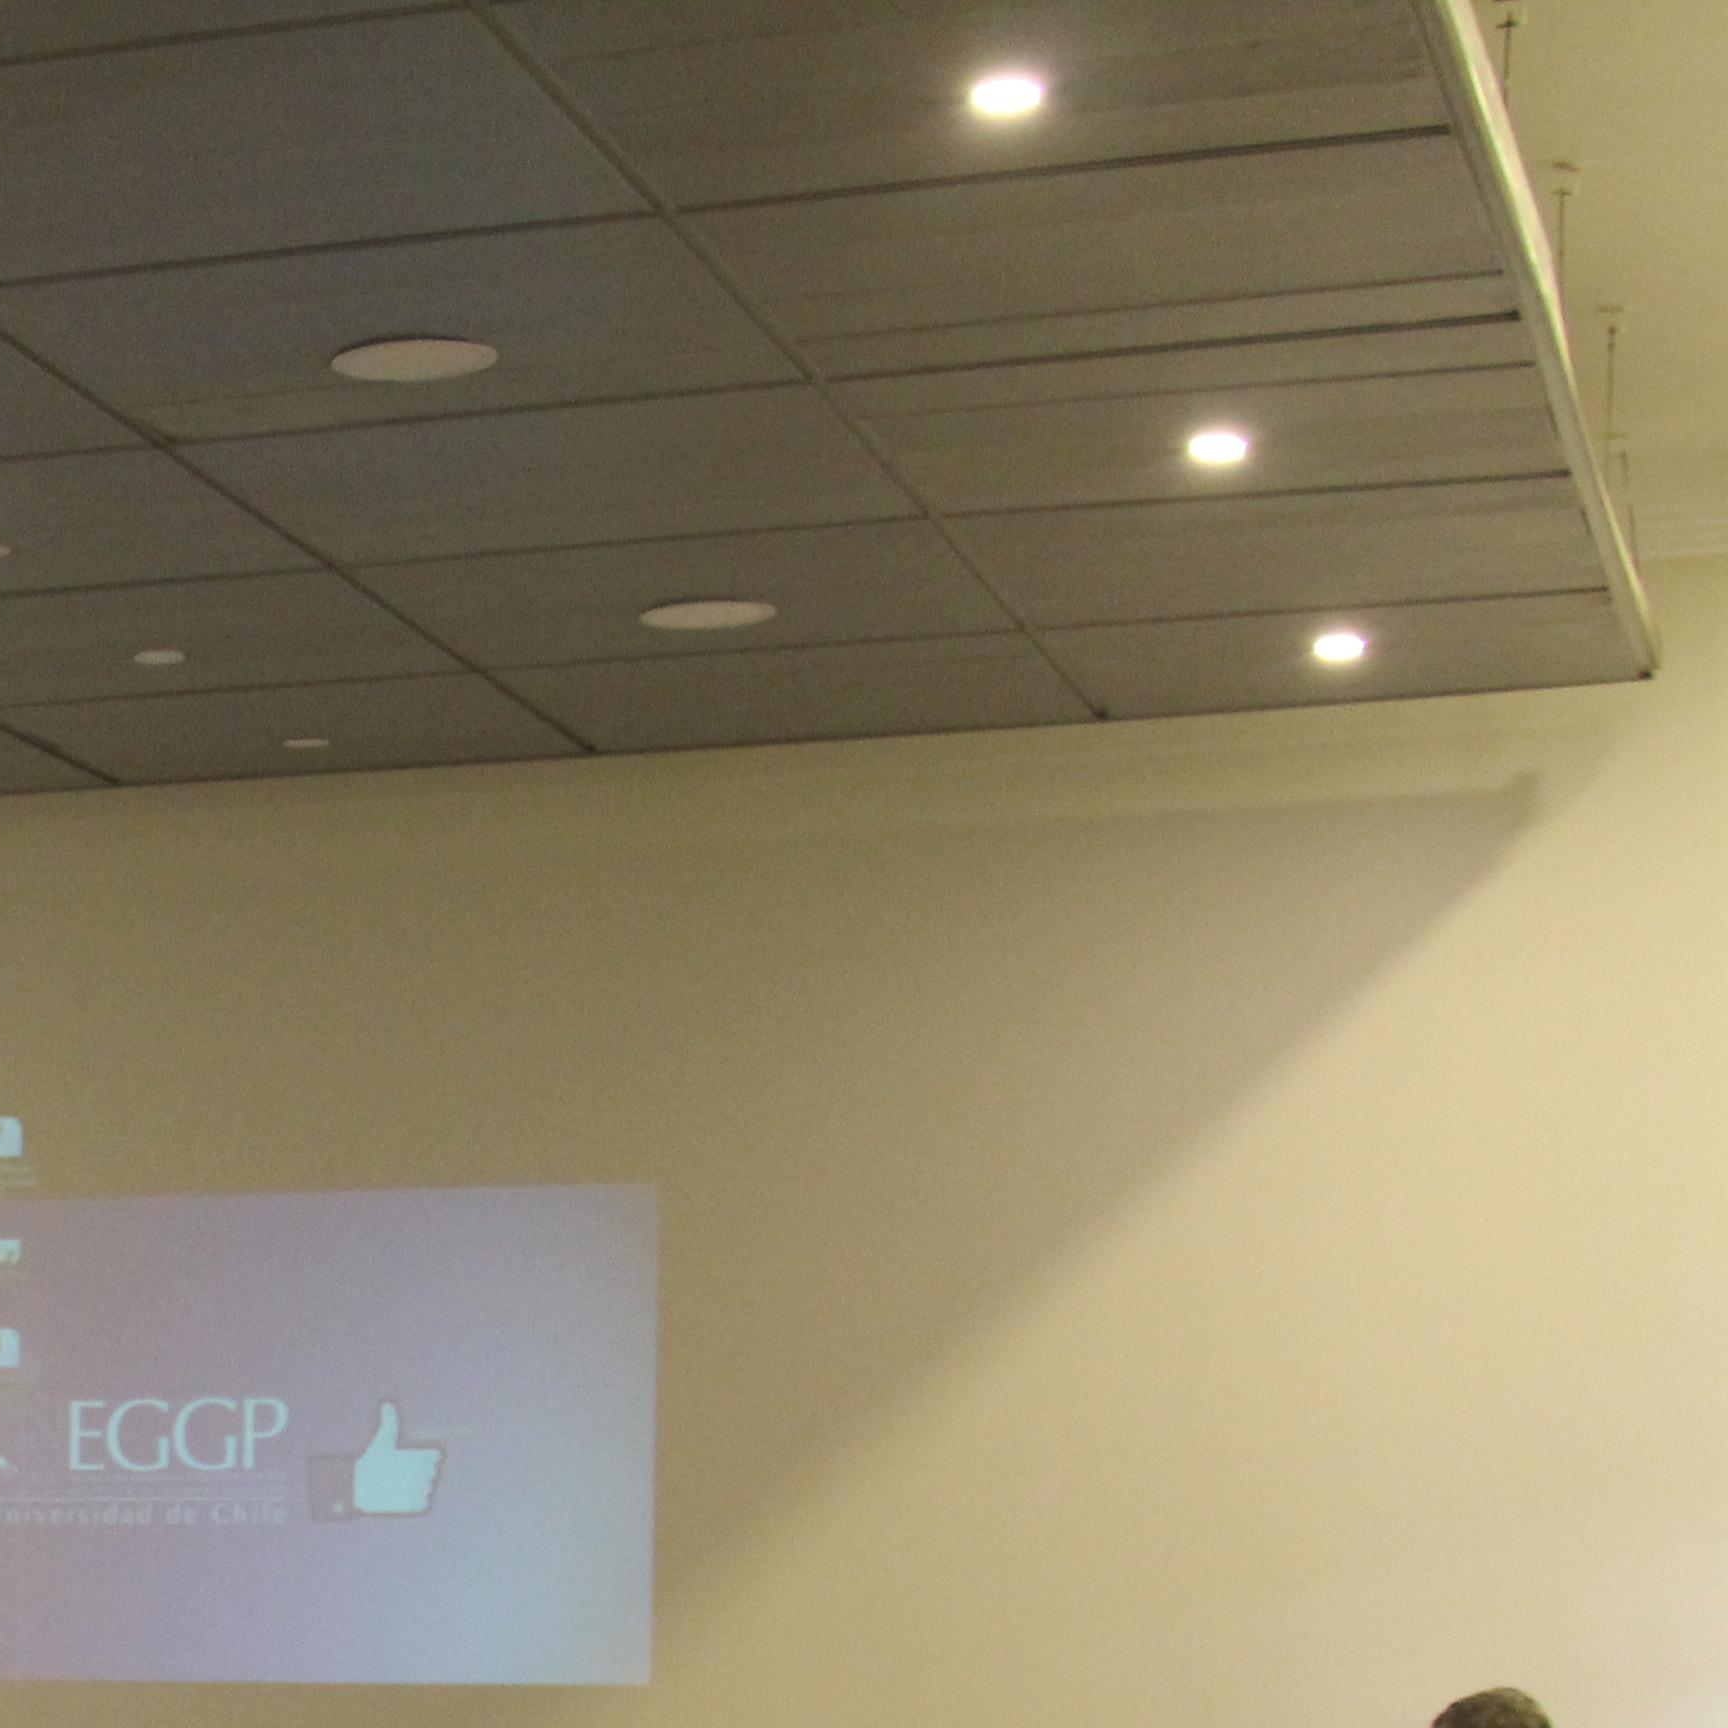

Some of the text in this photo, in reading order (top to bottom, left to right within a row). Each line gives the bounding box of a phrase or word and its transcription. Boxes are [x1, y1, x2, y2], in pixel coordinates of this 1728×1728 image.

[68, 1398, 289, 1471] EGGP
[166, 1503, 196, 1525] de
[212, 1503, 289, 1525] Chile
